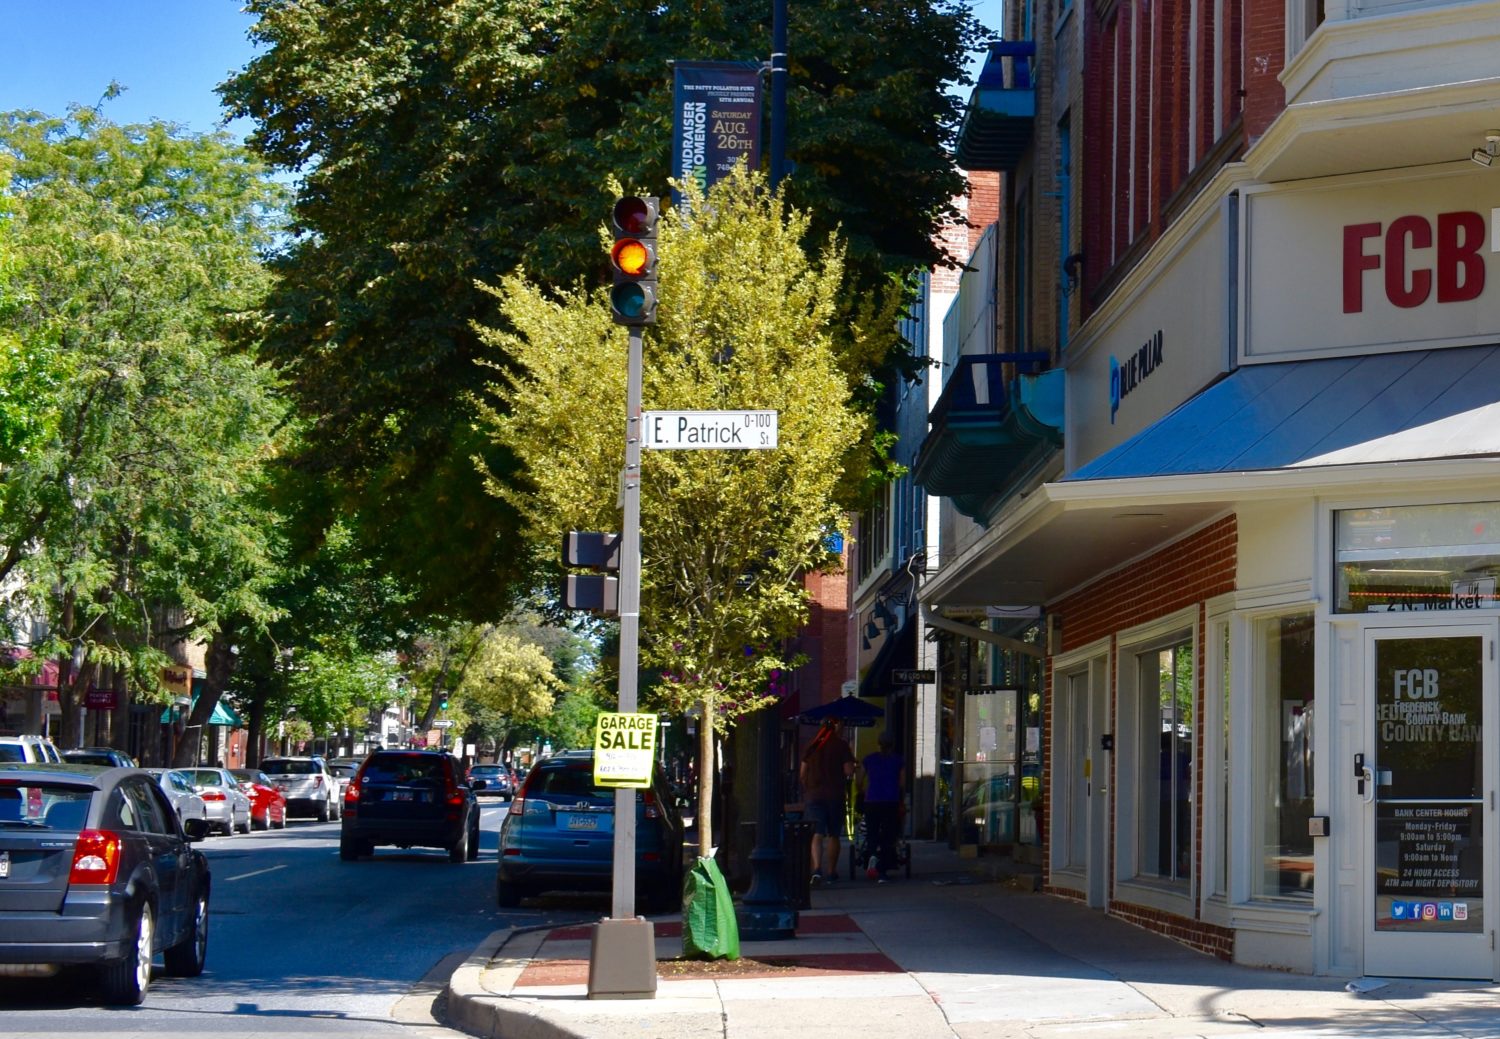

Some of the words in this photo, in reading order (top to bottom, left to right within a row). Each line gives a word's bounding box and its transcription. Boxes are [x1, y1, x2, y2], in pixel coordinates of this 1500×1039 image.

[711, 110, 752, 119] SATURDAY
[712, 120, 749, 134] AUG.
[717, 135, 753, 150] 26TH
[1343, 210, 1486, 314] FCB
[1120, 353, 1138, 400] BLUE
[1138, 329, 1163, 383] PILLAR
[744, 414, 771, 428] 0-100
[654, 417, 669, 443] E.
[678, 416, 742, 443] Patrick
[760, 431, 769, 445] St
[1387, 597, 1396, 612] 2
[1401, 598, 1418, 611] N.
[1423, 593, 1481, 611] Market
[1394, 668, 1439, 700] FCB
[1395, 700, 1440, 713] FREDERICK
[600, 716, 653, 730] GARAGE
[1405, 711, 1440, 726] COUNTY
[1442, 711, 1466, 725] BANK
[600, 730, 652, 750] SALE
[1395, 808, 1414, 817] BANK
[1416, 808, 1443, 817] CENTER
[1444, 808, 1468, 817] HOURS
[1405, 822, 1457, 832] Monday-Friday
[1400, 833, 1425, 841] 9:00am
[1427, 833, 1434, 841] to
[1416, 843, 1446, 853] Saturday
[1403, 869, 1412, 877] 24
[1414, 869, 1432, 877] HOUR
[1433, 869, 1460, 877] ACCESS
[1385, 879, 1400, 887] ATM
[1400, 879, 1413, 887] and
[1415, 879, 1436, 887] NIGHT
[1437, 879, 1479, 888] DEPOSITORY
